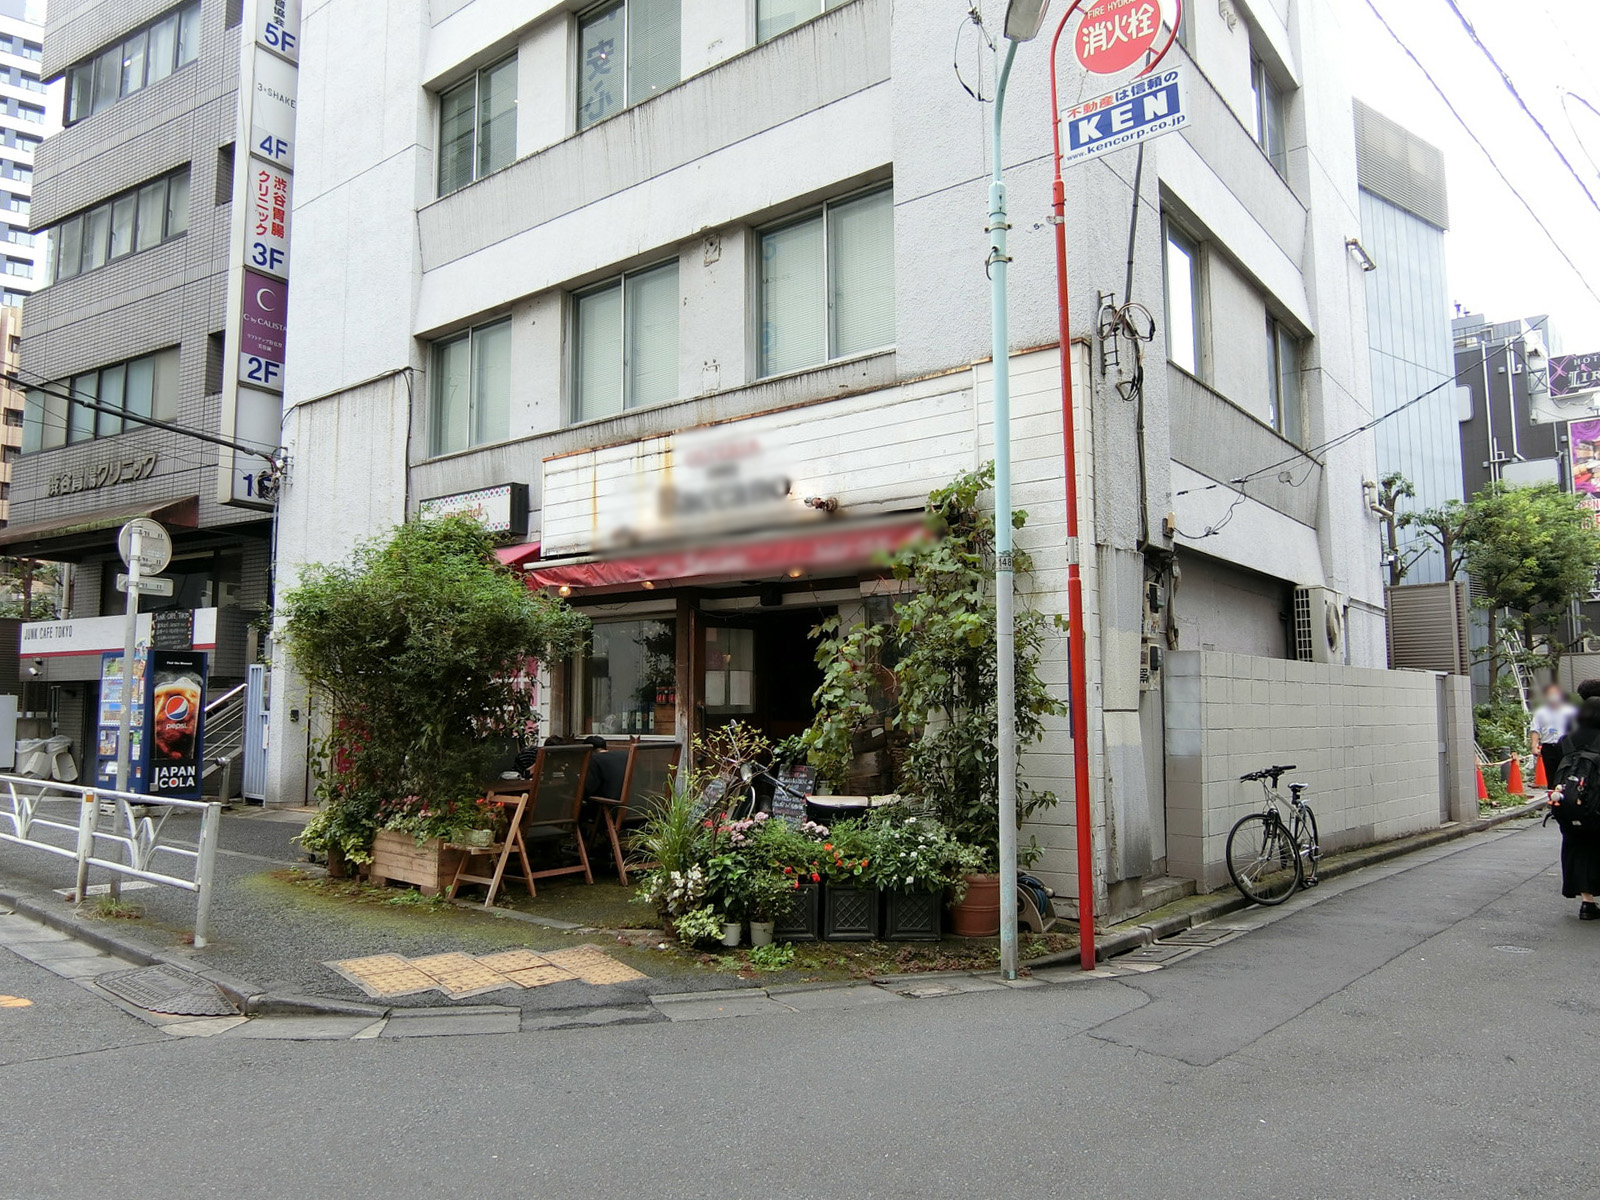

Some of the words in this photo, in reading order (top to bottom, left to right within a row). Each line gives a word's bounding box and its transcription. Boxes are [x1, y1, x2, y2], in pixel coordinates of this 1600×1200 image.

[1087, 5, 1105, 19] FIRE
[264, 22, 296, 51] 5F
[1081, 3, 1155, 58] 消火栓
[1067, 71, 1178, 119] 不動産は信頼の
[1078, 90, 1169, 144] KEN
[259, 135, 288, 159] 4F
[1066, 115, 1186, 161] www.kencorp.co.jp
[255, 171, 270, 236] クリニック
[271, 176, 287, 239] 渋谷胃腸
[252, 242, 285, 270] 3F
[247, 357, 280, 384] 2F
[48, 453, 158, 497] 渋谷胃腸クリニック
[999, 557, 1011, 566] 148
[25, 628, 38, 640] JUNK
[40, 627, 53, 639] CAFE
[55, 625, 72, 638] TOKYO
[165, 722, 187, 730] pepsi
[150, 766, 196, 792] JAPAN
[159, 777, 196, 788] COLA
